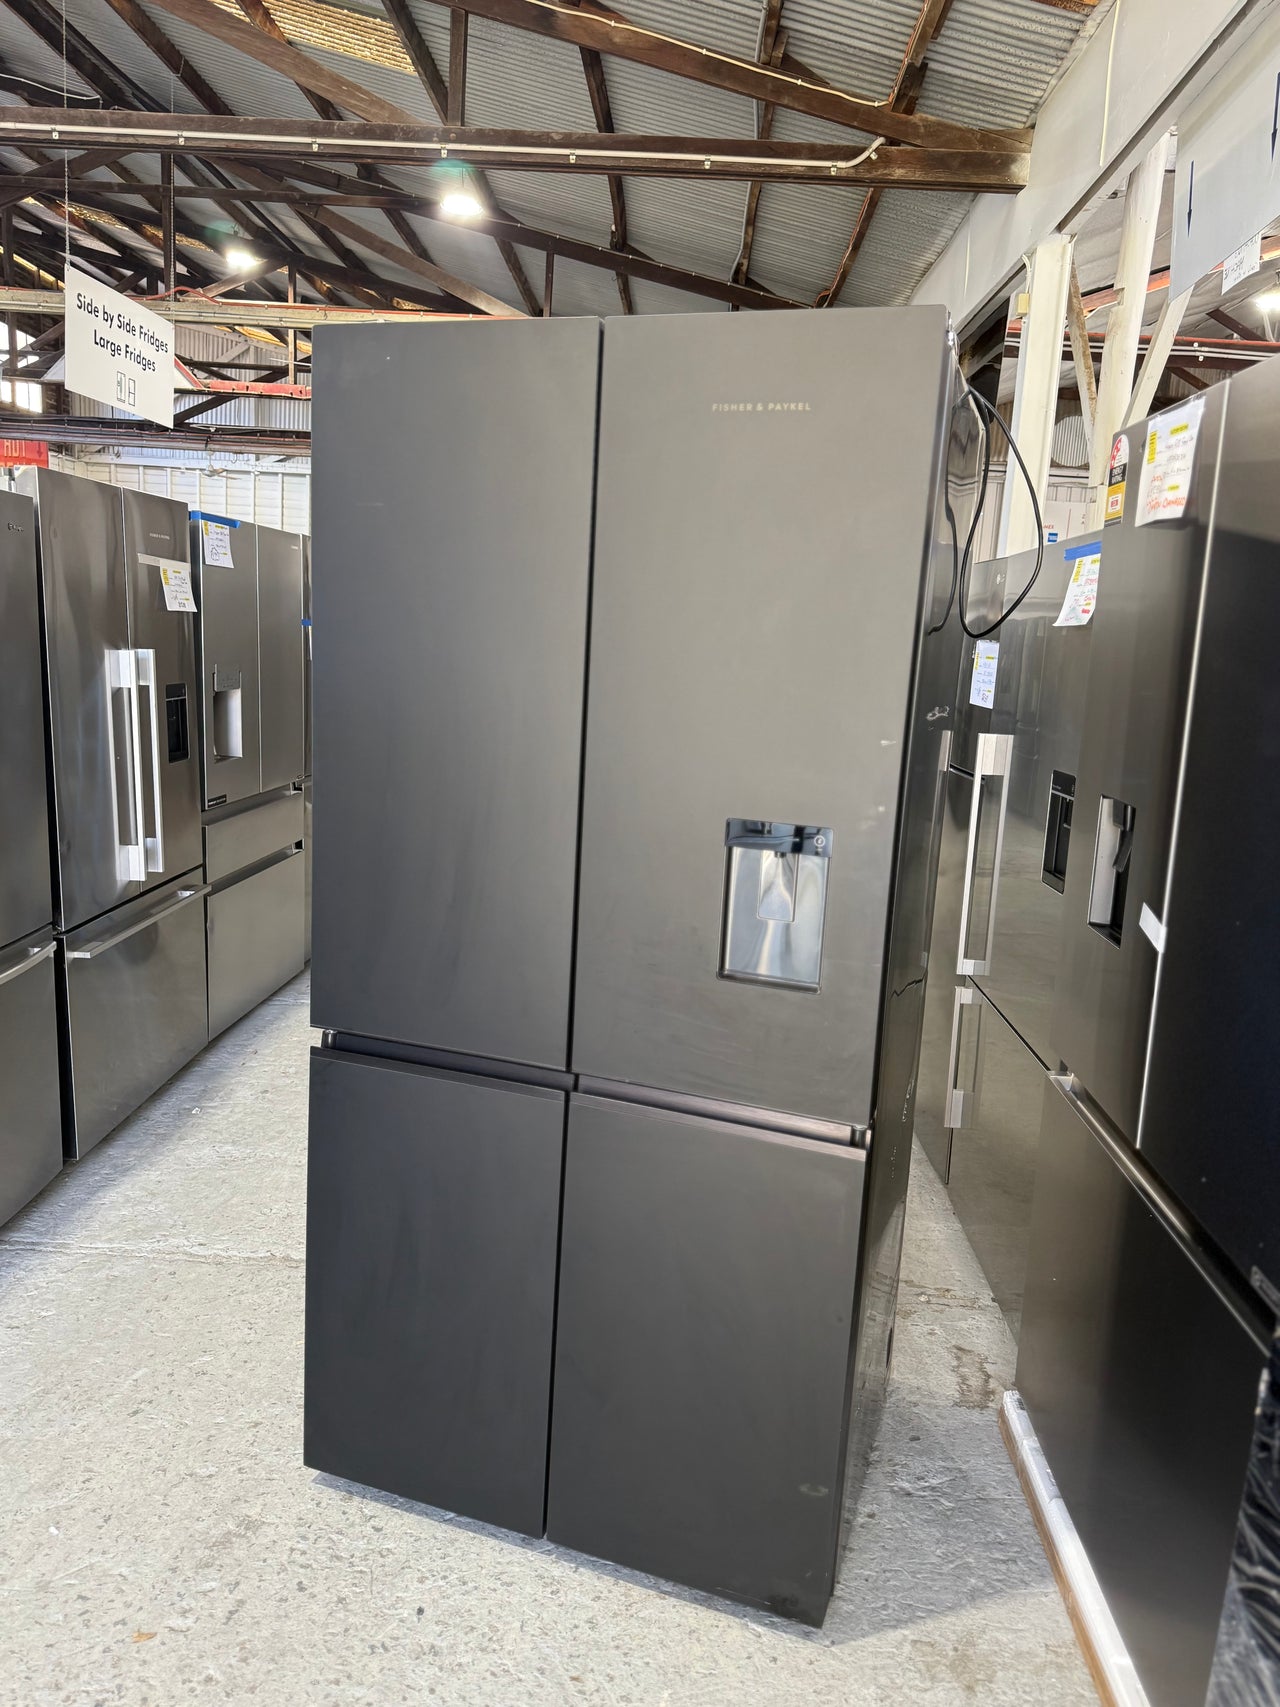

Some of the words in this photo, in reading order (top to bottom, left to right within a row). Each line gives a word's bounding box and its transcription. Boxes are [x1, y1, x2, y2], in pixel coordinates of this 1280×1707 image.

[76, 292, 100, 319] Side
[102, 304, 115, 329] by
[117, 313, 137, 337] Side
[139, 325, 169, 354] Fridges
[93, 329, 123, 357] Large
[124, 348, 156, 372] Fridges
[712, 403, 753, 412] FISHER
[756, 402, 764, 411] &
[767, 402, 811, 411] PAYKEL
